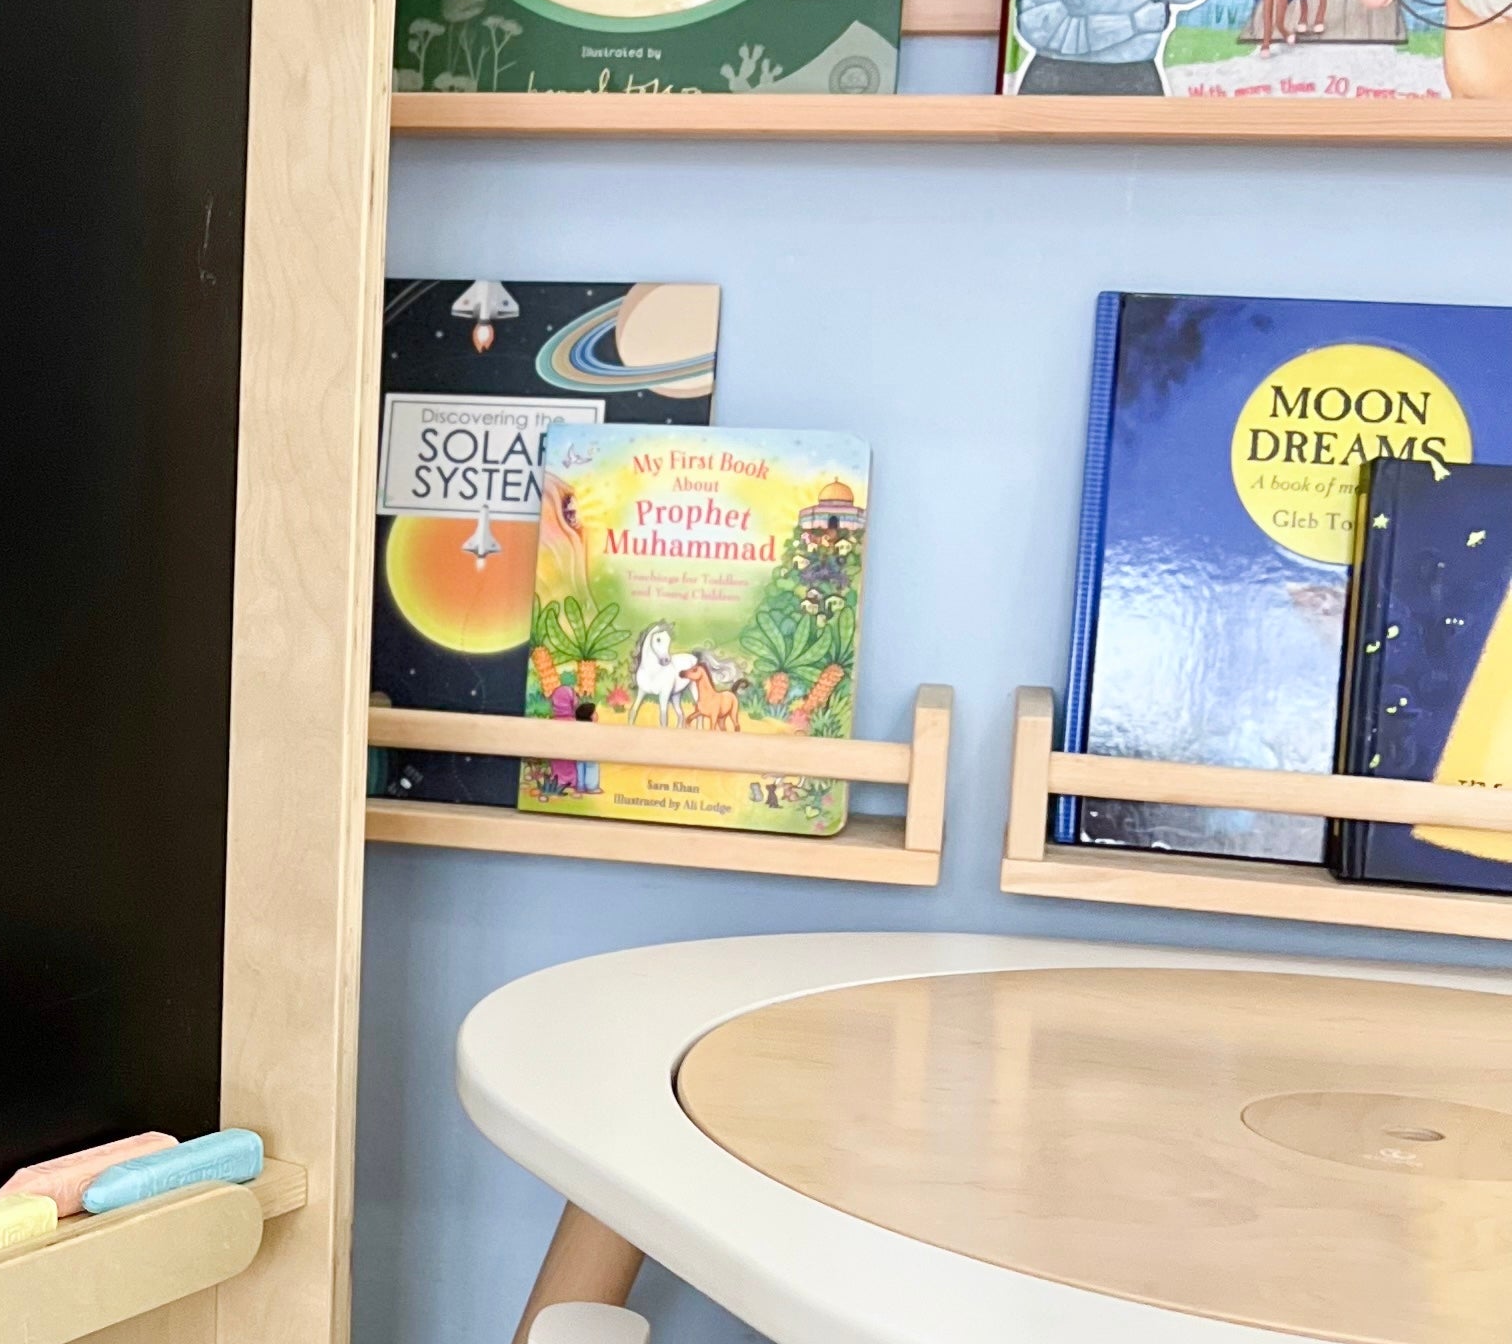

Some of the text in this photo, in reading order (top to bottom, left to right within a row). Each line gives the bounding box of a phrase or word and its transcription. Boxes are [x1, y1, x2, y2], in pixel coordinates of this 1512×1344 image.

[581, 45, 662, 60] Illustrated by
[1234, 83, 1272, 97] more
[1280, 77, 1316, 94] than
[1324, 74, 1350, 97] 20
[1269, 384, 1432, 425] MOON
[421, 407, 528, 430] Discovering
[1246, 428, 1447, 466] DREAMS
[632, 449, 770, 480] My First Book
[672, 476, 720, 493] About
[635, 497, 752, 532] Prophet
[1272, 509, 1319, 530] Gleb
[602, 528, 777, 562] Muhammad
[647, 779, 700, 794] Sara Khan
[668, 798, 681, 811] by
[683, 799, 698, 811] Ali
[700, 802, 732, 815] Lodge
